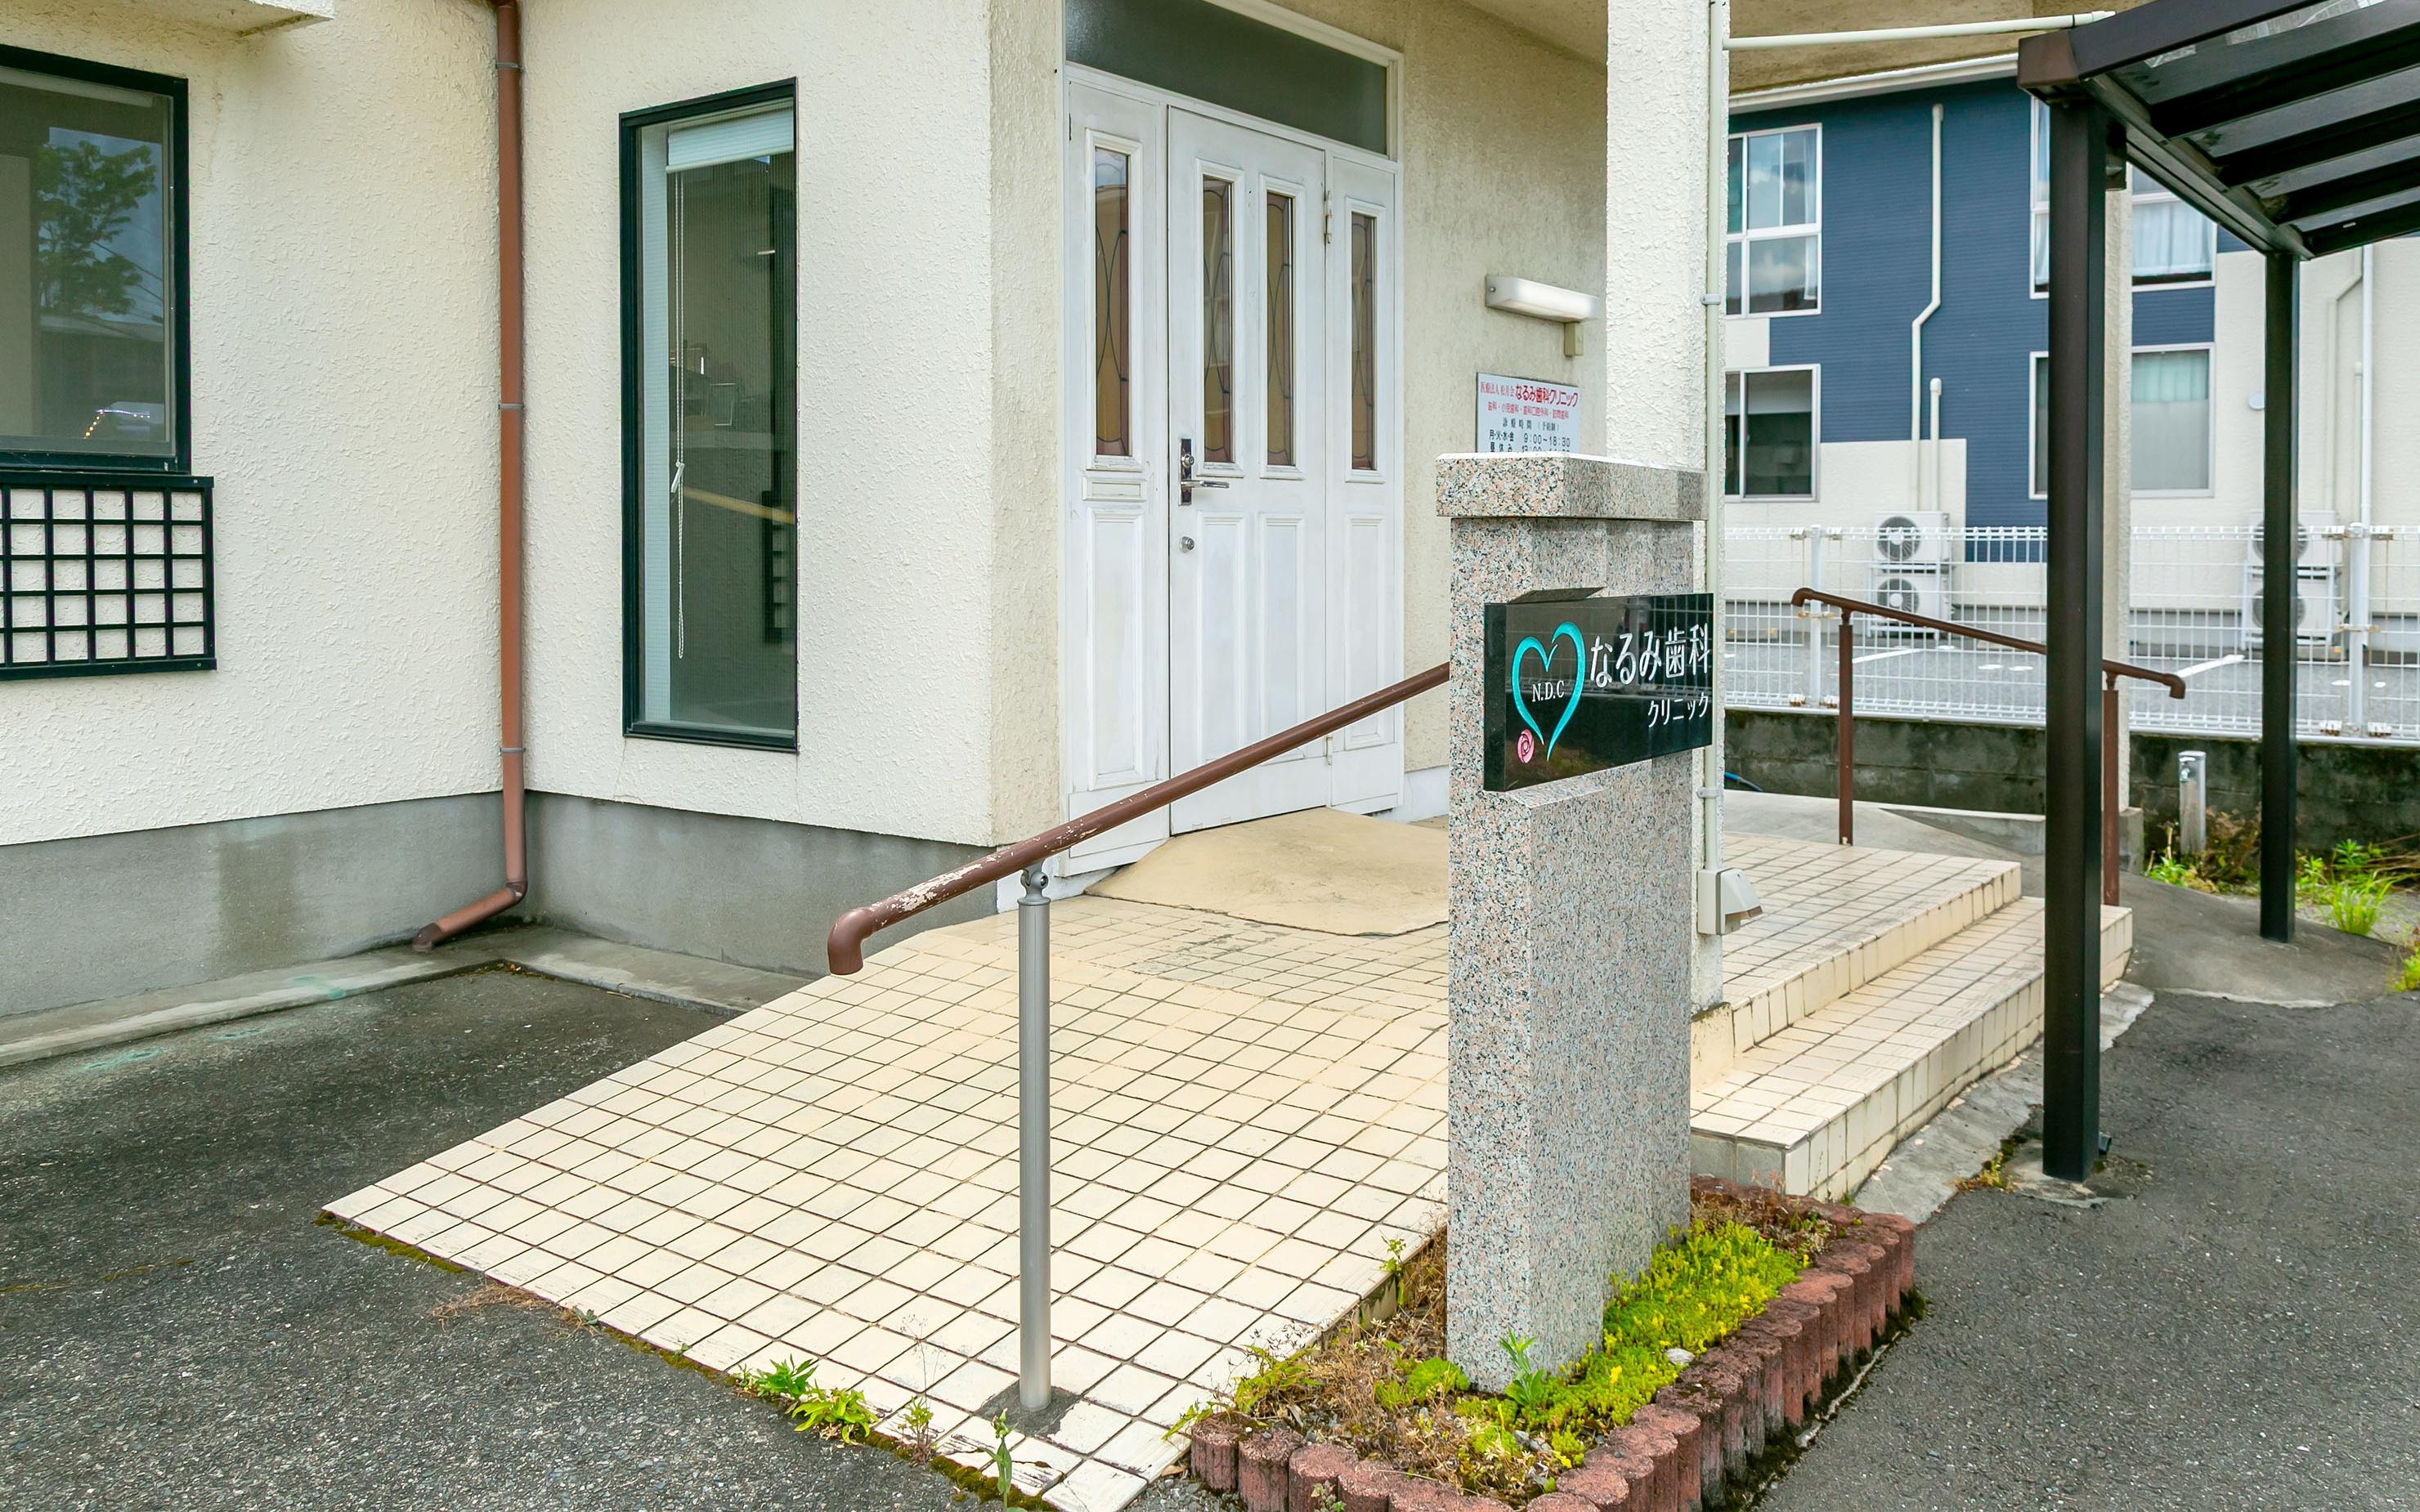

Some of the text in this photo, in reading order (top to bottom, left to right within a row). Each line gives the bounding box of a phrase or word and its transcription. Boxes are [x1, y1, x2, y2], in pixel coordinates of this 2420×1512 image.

[1516, 384, 1579, 407] なるみ歯科クリニック
[1590, 622, 1710, 688] なるみ歯科
[1531, 680, 1565, 703] N.D.C
[1647, 691, 1710, 728] クリニック
